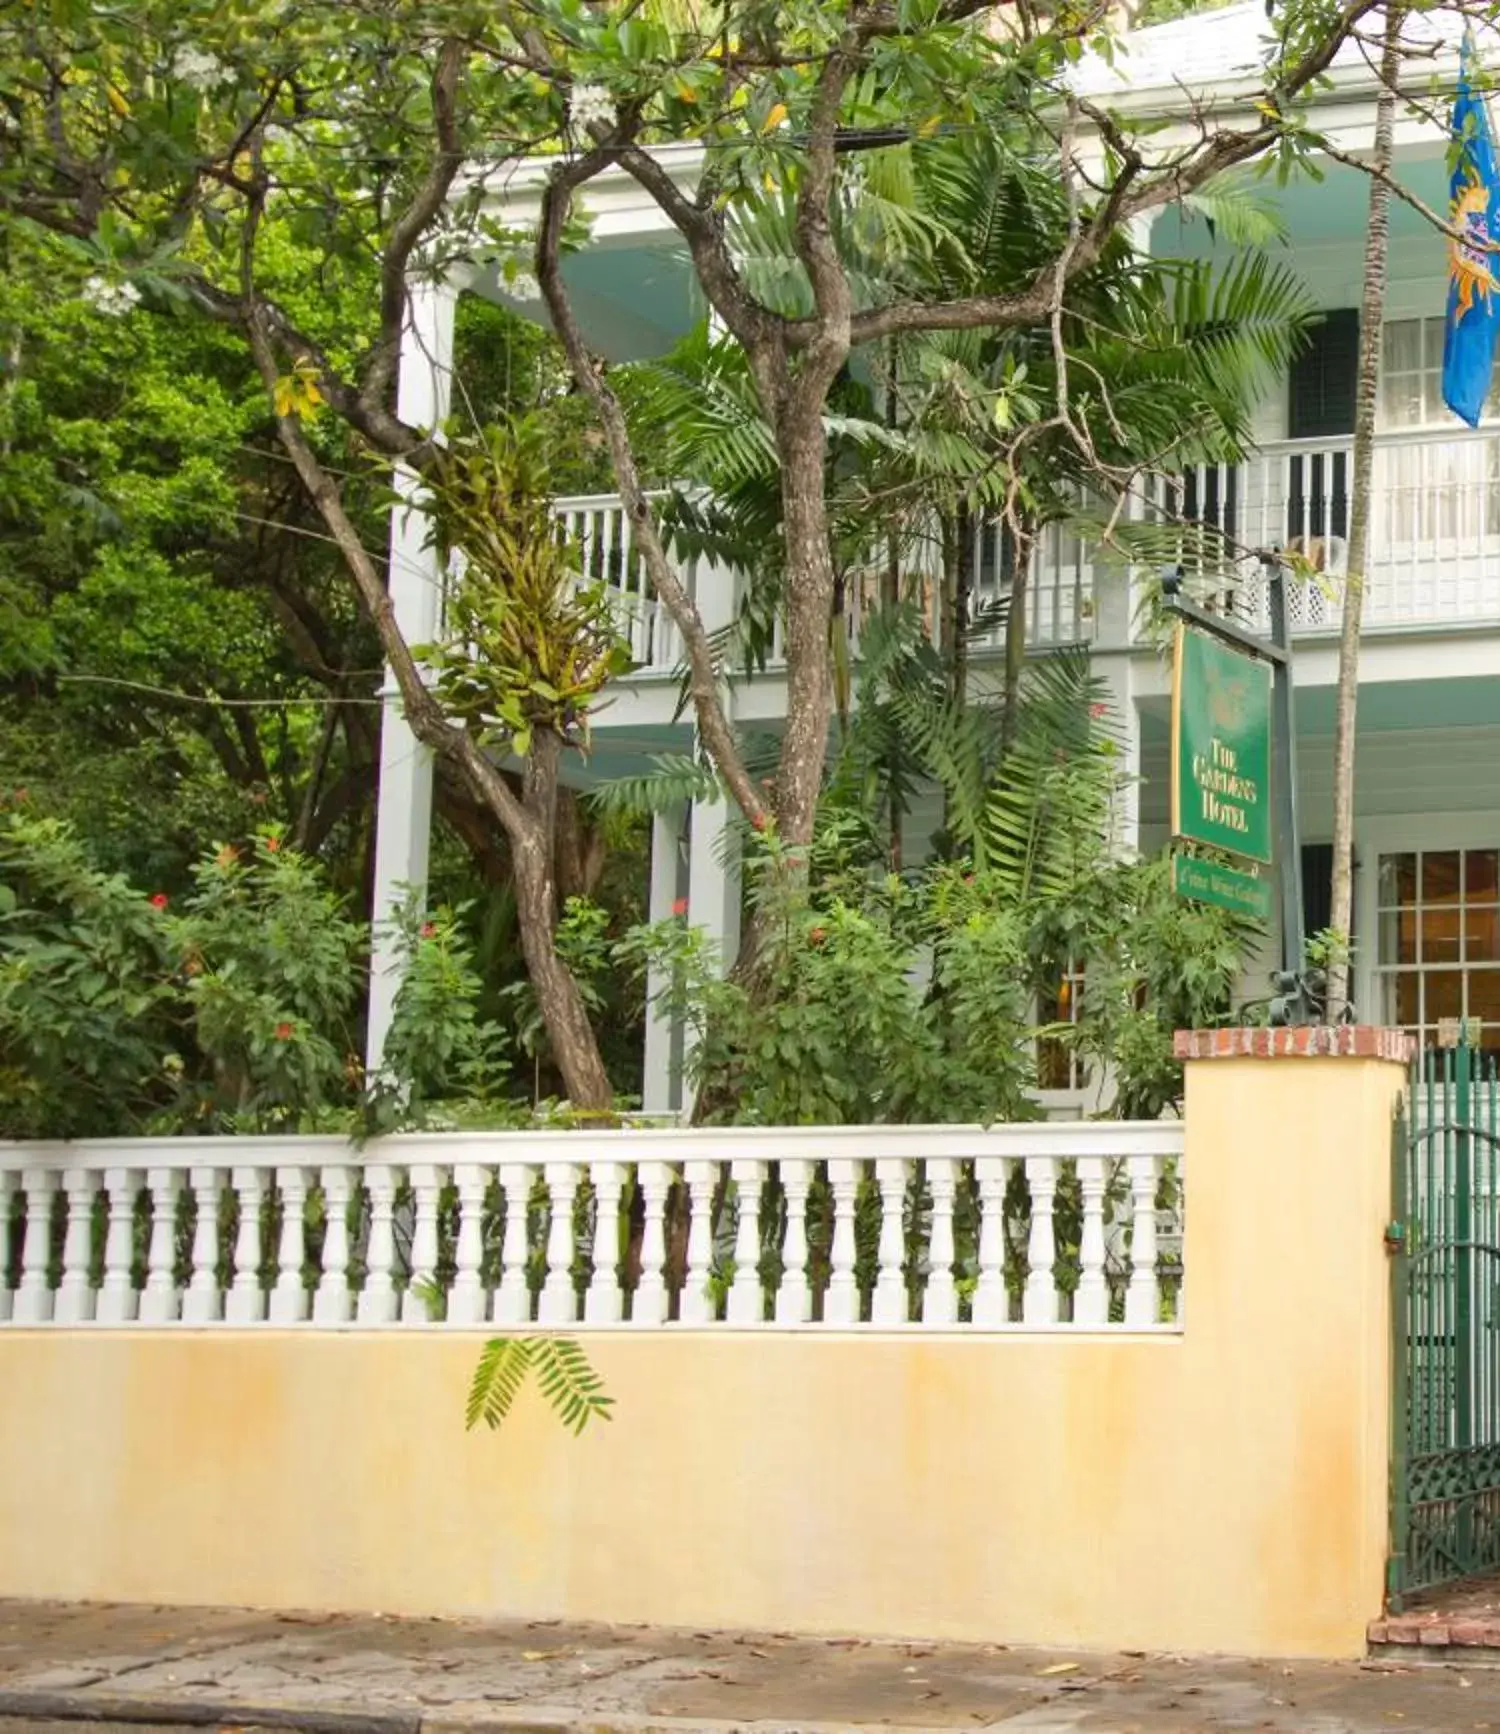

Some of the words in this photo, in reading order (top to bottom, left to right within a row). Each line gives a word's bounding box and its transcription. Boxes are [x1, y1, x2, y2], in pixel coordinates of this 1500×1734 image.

[1210, 737, 1237, 772] THE
[1193, 754, 1257, 805] GARDENS
[1202, 790, 1249, 833] HOTEL
